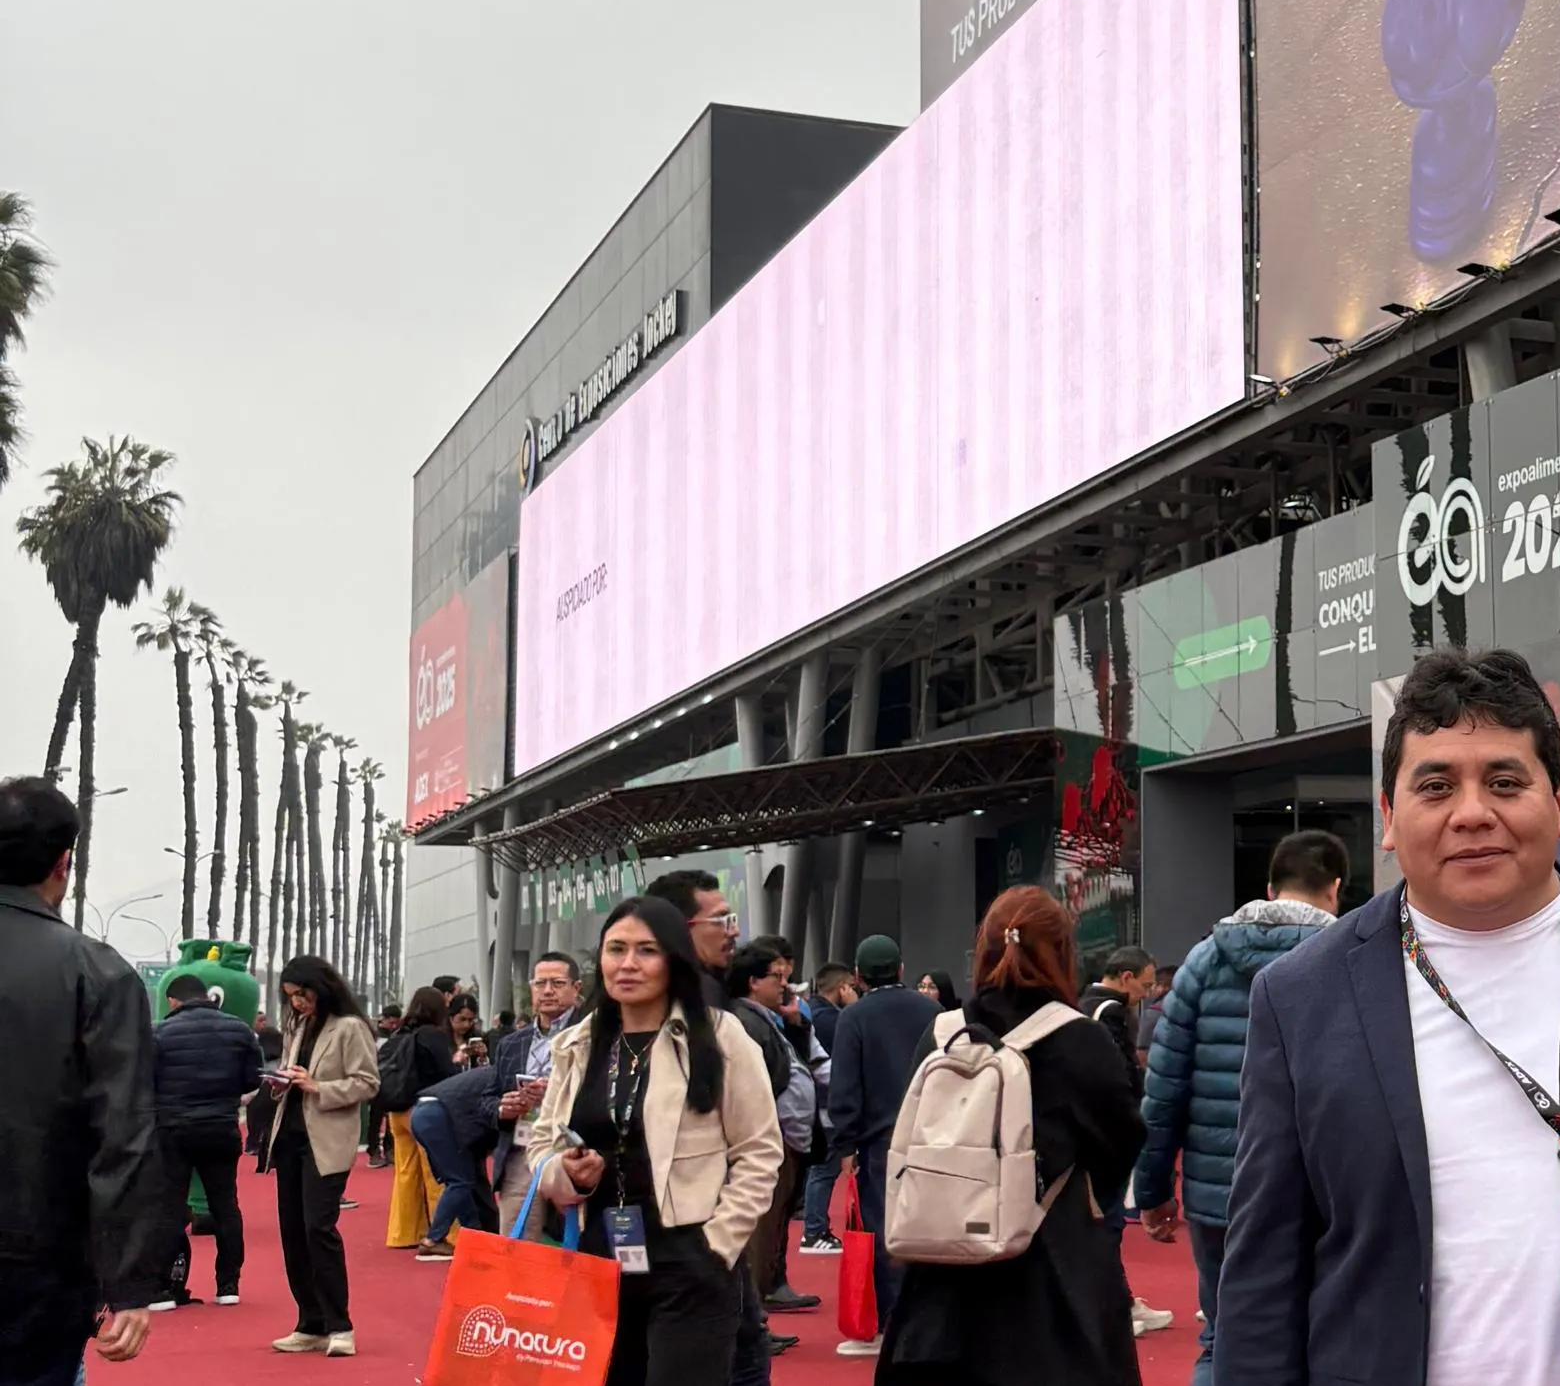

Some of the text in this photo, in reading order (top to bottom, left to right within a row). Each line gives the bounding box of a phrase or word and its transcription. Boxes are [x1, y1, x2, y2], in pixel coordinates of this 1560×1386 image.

[950, 7, 975, 63] TUS
[643, 289, 677, 359] Jockey
[1318, 566, 1338, 592] TUS
[1358, 624, 1377, 654] EL
